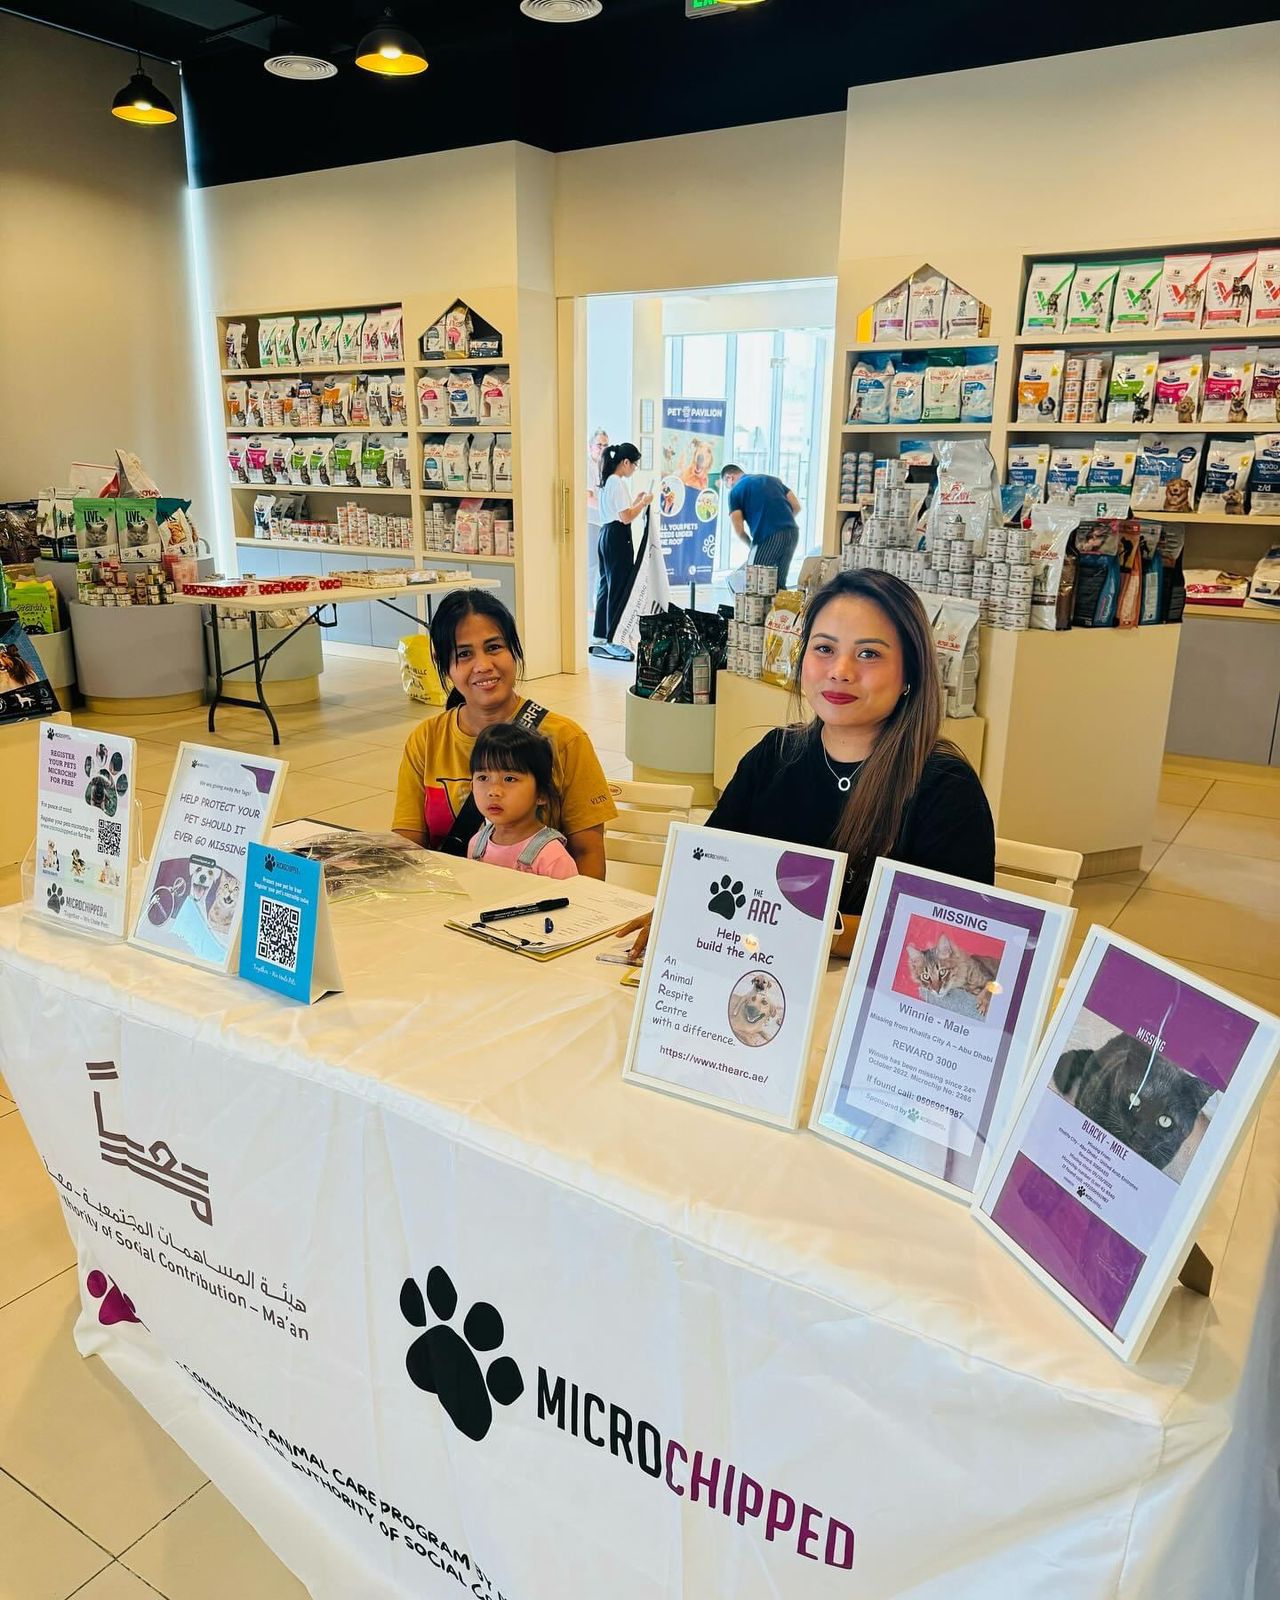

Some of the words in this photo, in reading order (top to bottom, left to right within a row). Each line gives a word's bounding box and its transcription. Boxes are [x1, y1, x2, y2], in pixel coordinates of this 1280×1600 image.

[667, 407, 681, 417] PET
[691, 408, 723, 418] PAVILION
[83, 511, 100, 522] LIVE
[125, 511, 141, 522] LIVE
[49, 758, 63, 768] YOUR
[63, 761, 77, 770] PETS
[50, 749, 75, 761] REGISTER
[48, 767, 77, 779] MICROCHIP
[50, 776, 60, 784] FOR
[61, 778, 74, 788] FREE
[180, 793, 199, 805] HELP
[201, 797, 235, 813] PROTECT
[238, 805, 260, 819] YOUR
[184, 813, 199, 824] PET
[201, 817, 232, 833] SHOULD
[234, 825, 246, 836] IT
[174, 830, 193, 842] EVER
[195, 836, 206, 847] GO
[208, 840, 246, 856] MISSING
[754, 889, 764, 898] THE
[747, 898, 782, 926] ARC
[932, 906, 988, 931] MISSING
[717, 927, 741, 945] Help
[664, 955, 677, 966] An
[696, 937, 723, 953] build
[726, 945, 745, 958] the
[749, 952, 774, 965] ARC
[661, 969, 694, 986] Animal
[658, 984, 694, 1003] Respite
[655, 1000, 688, 1018] Centre
[899, 1002, 934, 1024] Winnie
[943, 1019, 970, 1037] Male
[652, 1016, 672, 1029] with
[674, 1023, 680, 1031] a
[682, 1024, 736, 1047] difference.
[870, 1012, 893, 1027] Missing
[894, 1021, 908, 1032] from
[909, 1026, 931, 1040] Khalifa
[932, 1035, 945, 1046] City
[946, 1041, 951, 1049] A
[958, 1045, 972, 1056] Abu
[973, 1050, 993, 1063] Dhabi
[1136, 1027, 1166, 1052] MISSING
[660, 1044, 769, 1085] https://www.thearc.ae/
[892, 1039, 934, 1062] REWARD
[936, 1056, 958, 1071] 3000
[868, 1057, 892, 1072] October
[911, 1073, 942, 1092] Microchip
[890, 1055, 901, 1066] has
[902, 1061, 917, 1073] been
[918, 1067, 944, 1083] missing
[945, 1078, 962, 1090] since
[874, 1078, 896, 1093] found
[898, 1086, 914, 1101] call:
[1081, 1119, 1107, 1144] BLACKY
[1110, 1140, 1129, 1161] MALE
[101, 1225, 113, 1239] of
[116, 1230, 156, 1263] Social
[159, 1251, 247, 1310] Contribution
[537, 1365, 855, 1570] MICROCHIPPED
[268, 1428, 329, 1475] ANIMAL
[332, 1468, 377, 1507] CARE
[379, 1499, 471, 1571] PROGRAM
[292, 1460, 375, 1525] AUTHORITY
[379, 1521, 400, 1541] OF
[404, 1535, 468, 1588] SOCIAL
